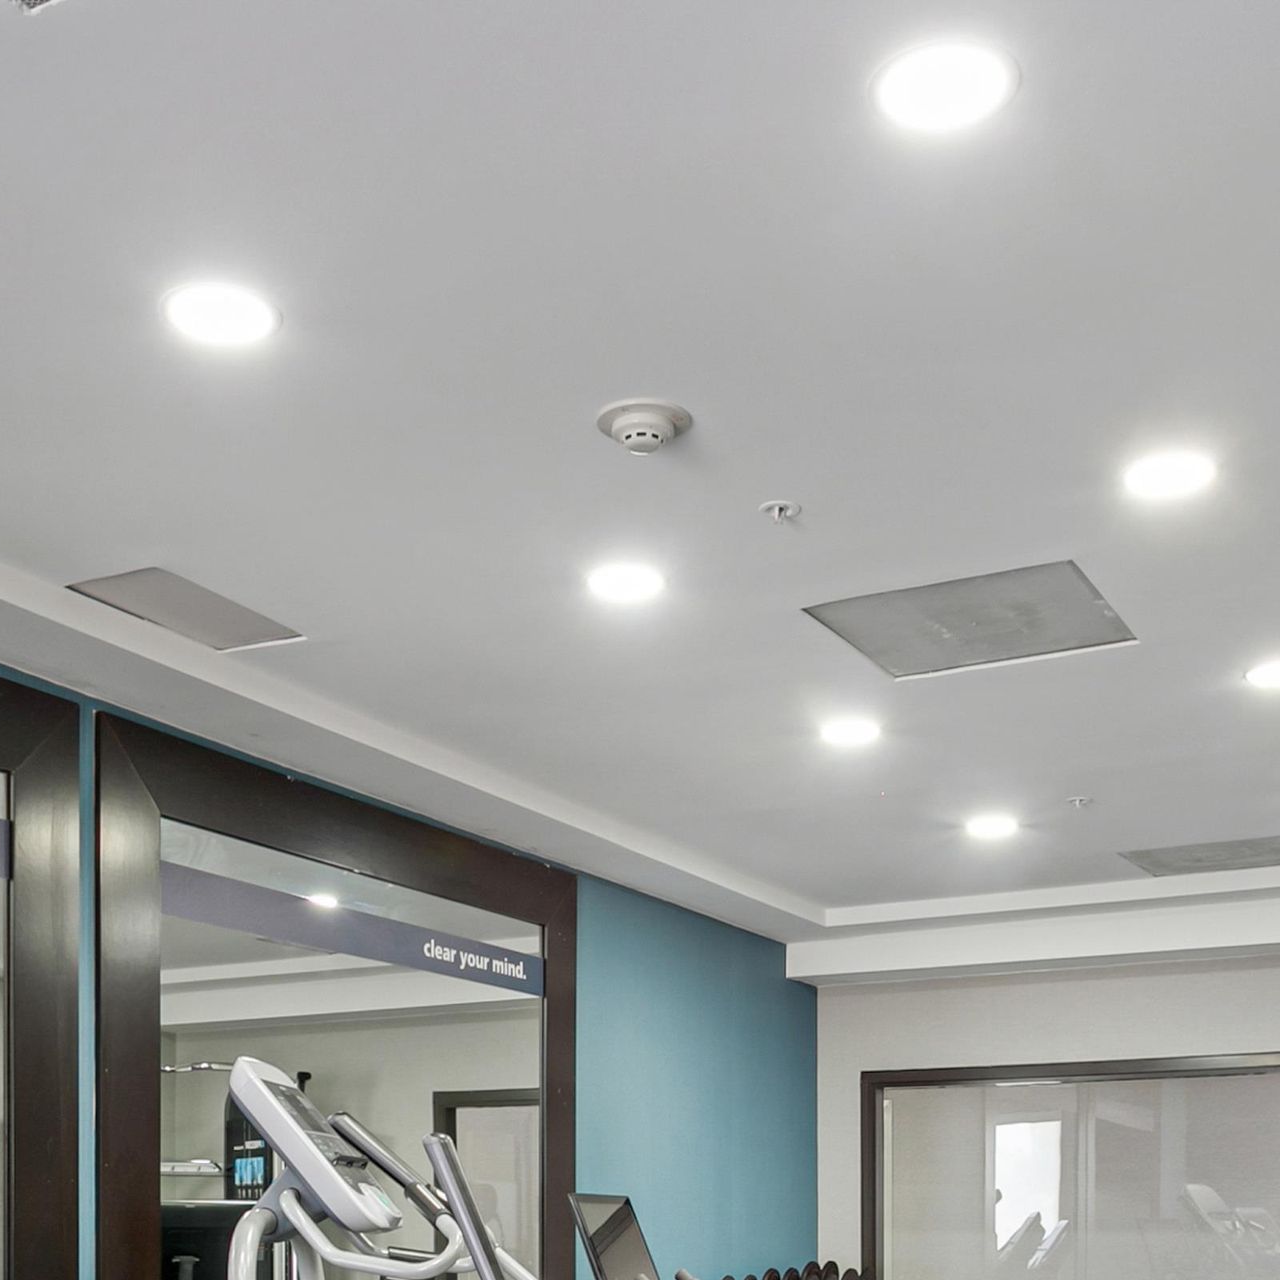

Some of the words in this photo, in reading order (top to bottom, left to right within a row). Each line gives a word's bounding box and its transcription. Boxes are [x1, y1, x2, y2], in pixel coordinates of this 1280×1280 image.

[423, 939, 457, 963] clear
[460, 951, 489, 970] your
[492, 957, 527, 980] mind.
